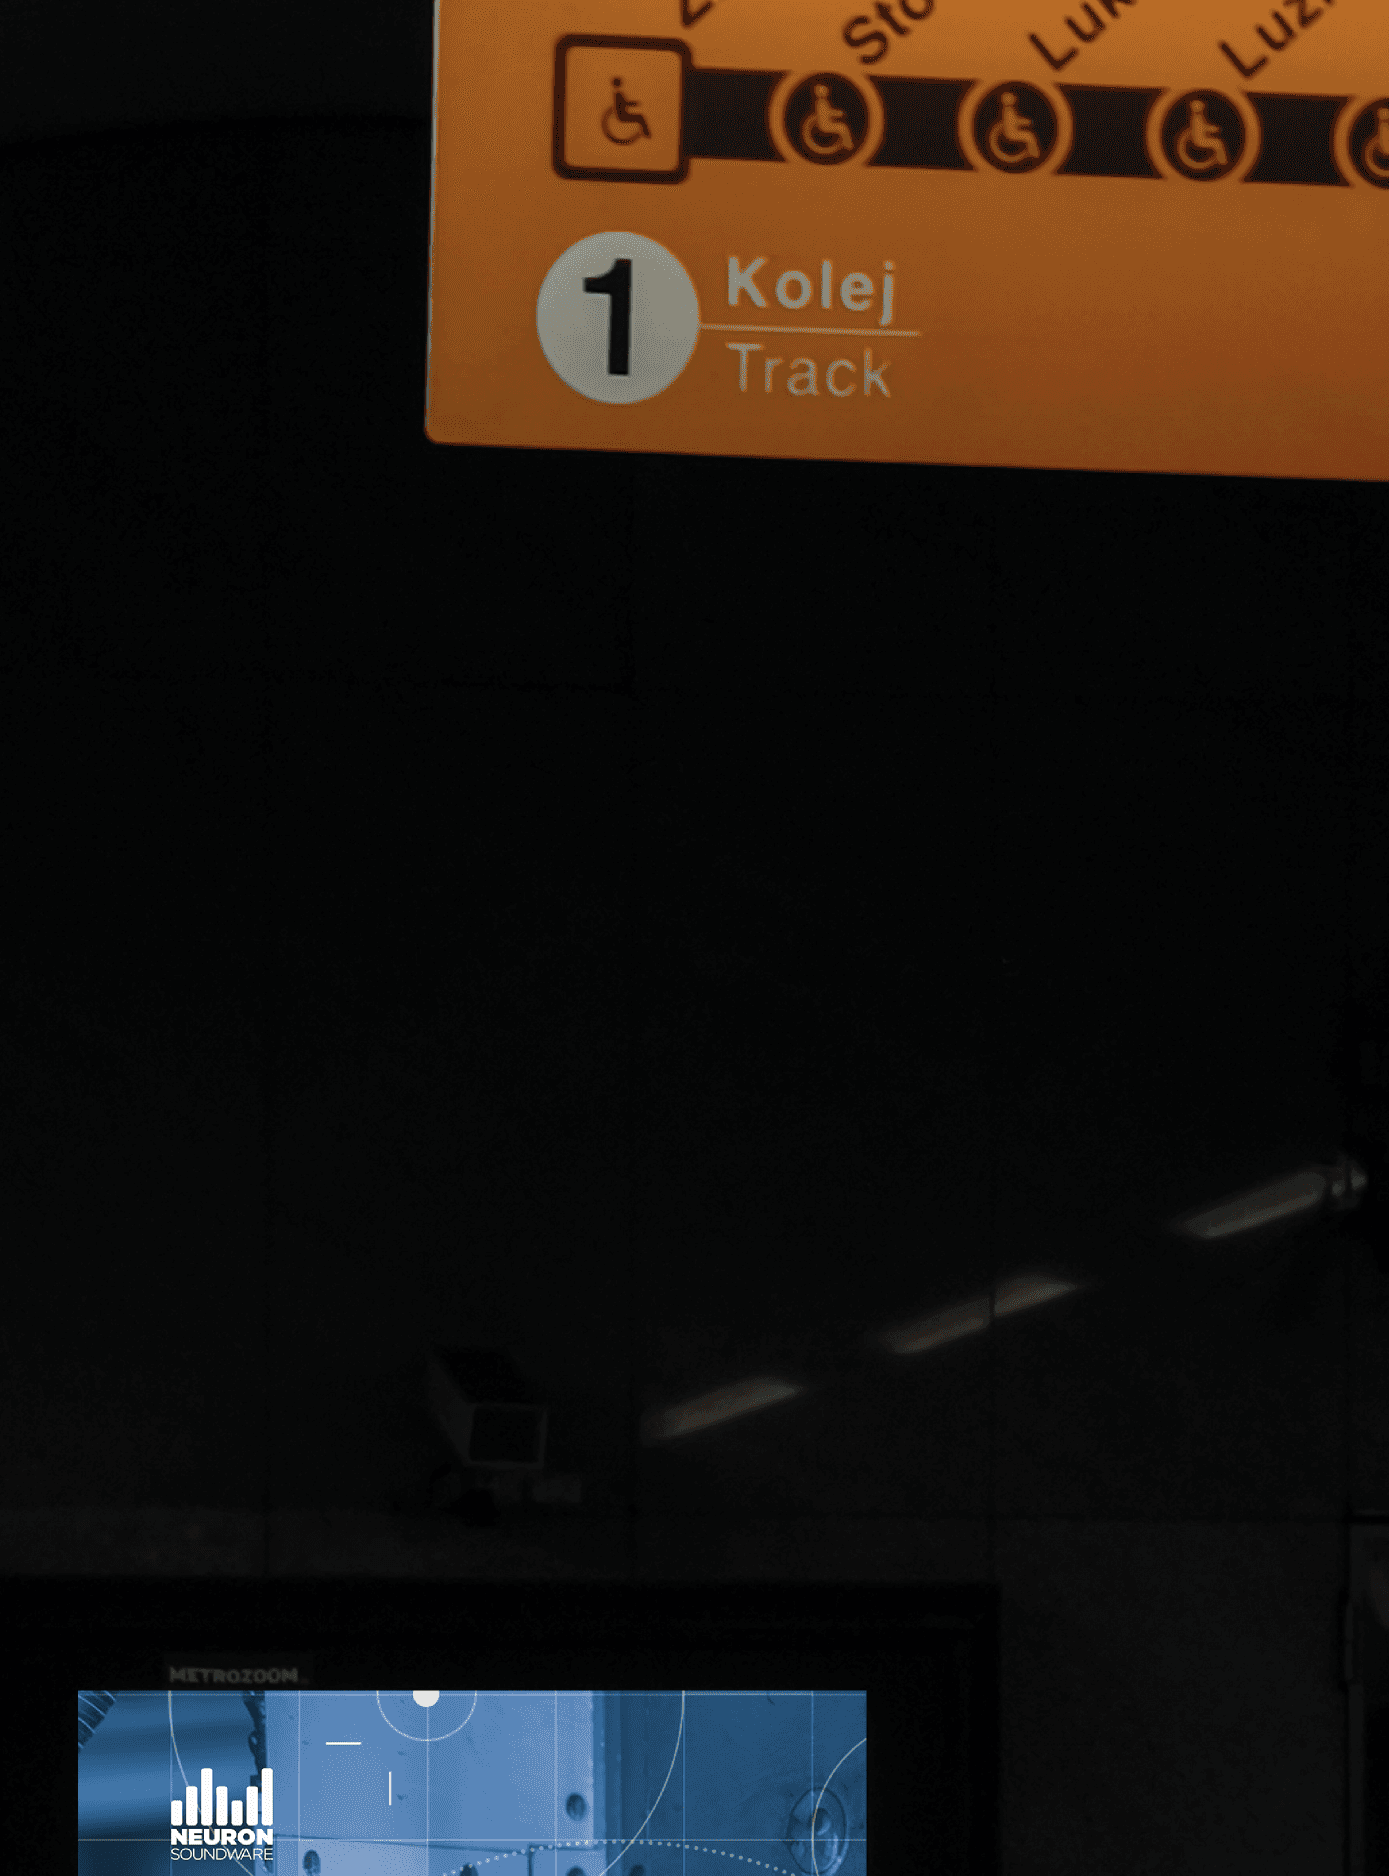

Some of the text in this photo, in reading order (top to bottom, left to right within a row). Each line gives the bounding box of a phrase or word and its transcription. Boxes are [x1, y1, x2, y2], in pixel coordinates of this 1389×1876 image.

[583, 256, 896, 376] 1 Kolej
[725, 341, 892, 399] Track
[170, 1848, 273, 1860] SOUNDWARE
[171, 1828, 273, 1846] NEURON
